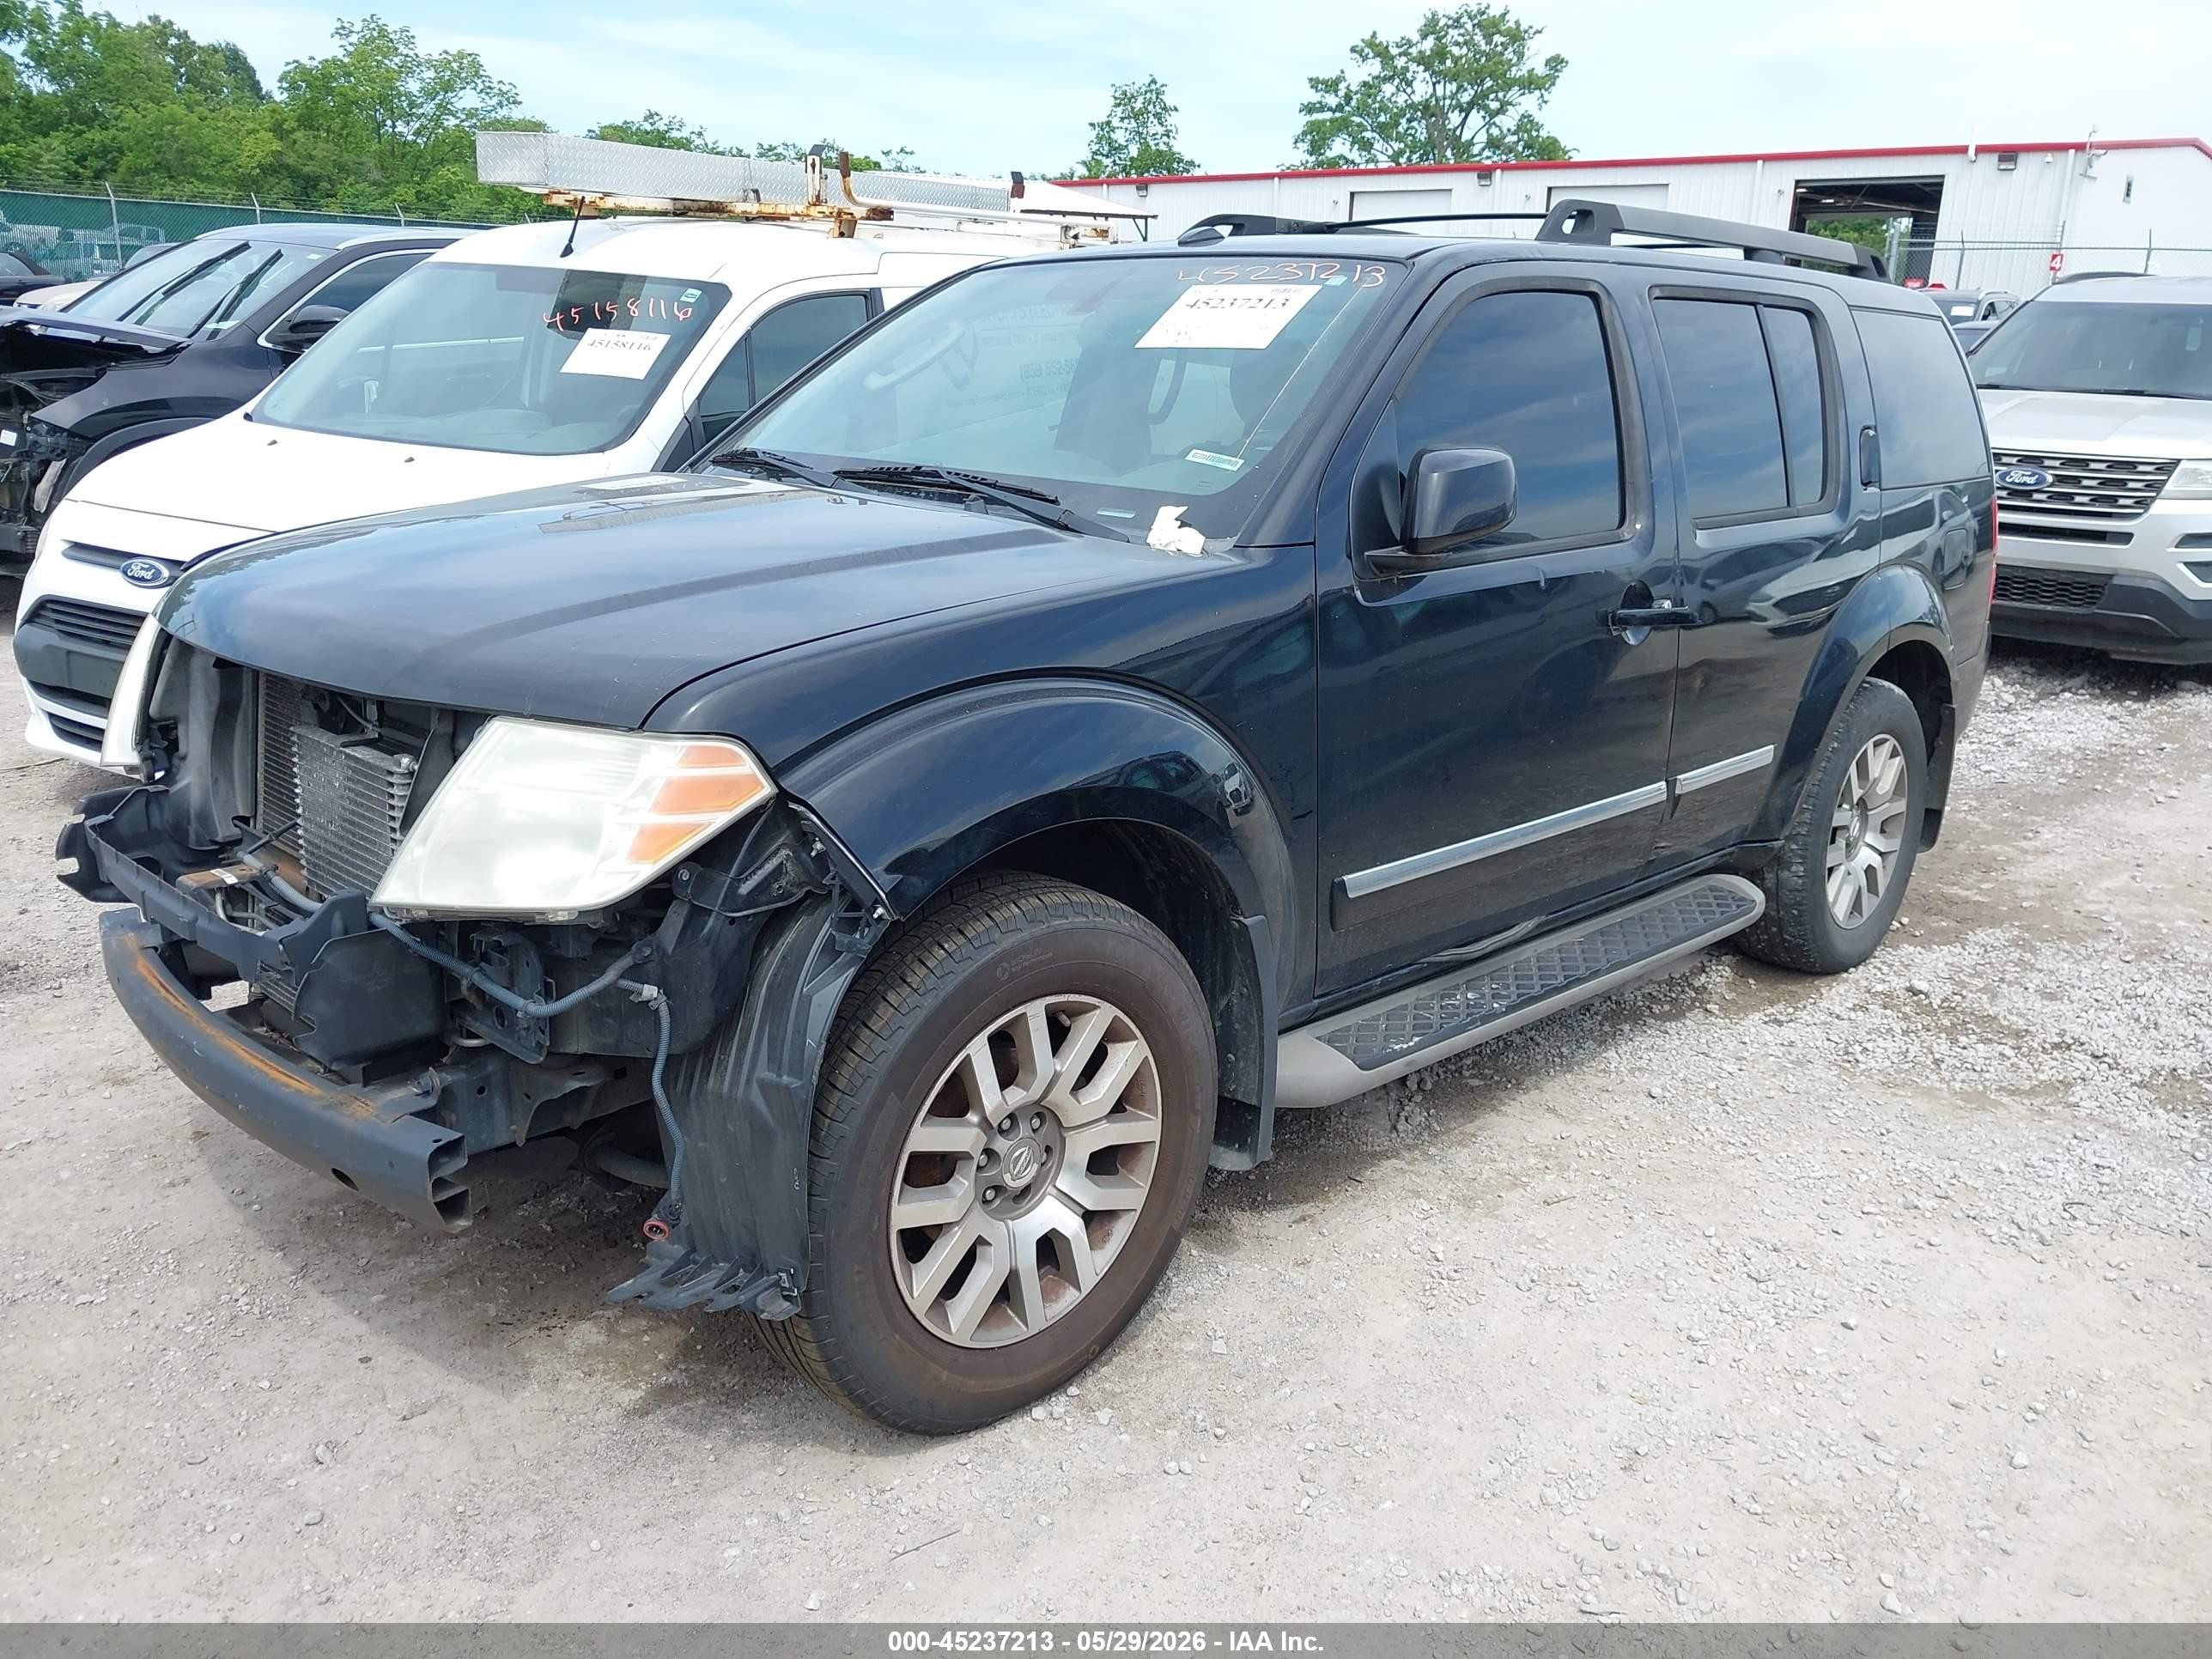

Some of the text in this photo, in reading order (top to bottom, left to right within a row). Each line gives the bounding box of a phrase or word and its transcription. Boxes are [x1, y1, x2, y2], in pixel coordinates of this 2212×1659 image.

[2051, 254, 2062, 270] 4
[1177, 262, 1388, 288] 45237213
[1186, 297, 1291, 310] 45237213
[542, 296, 693, 331] 45158116
[587, 338, 652, 352] 45158116
[2005, 470, 2039, 484] Ford
[126, 562, 155, 580] Ford
